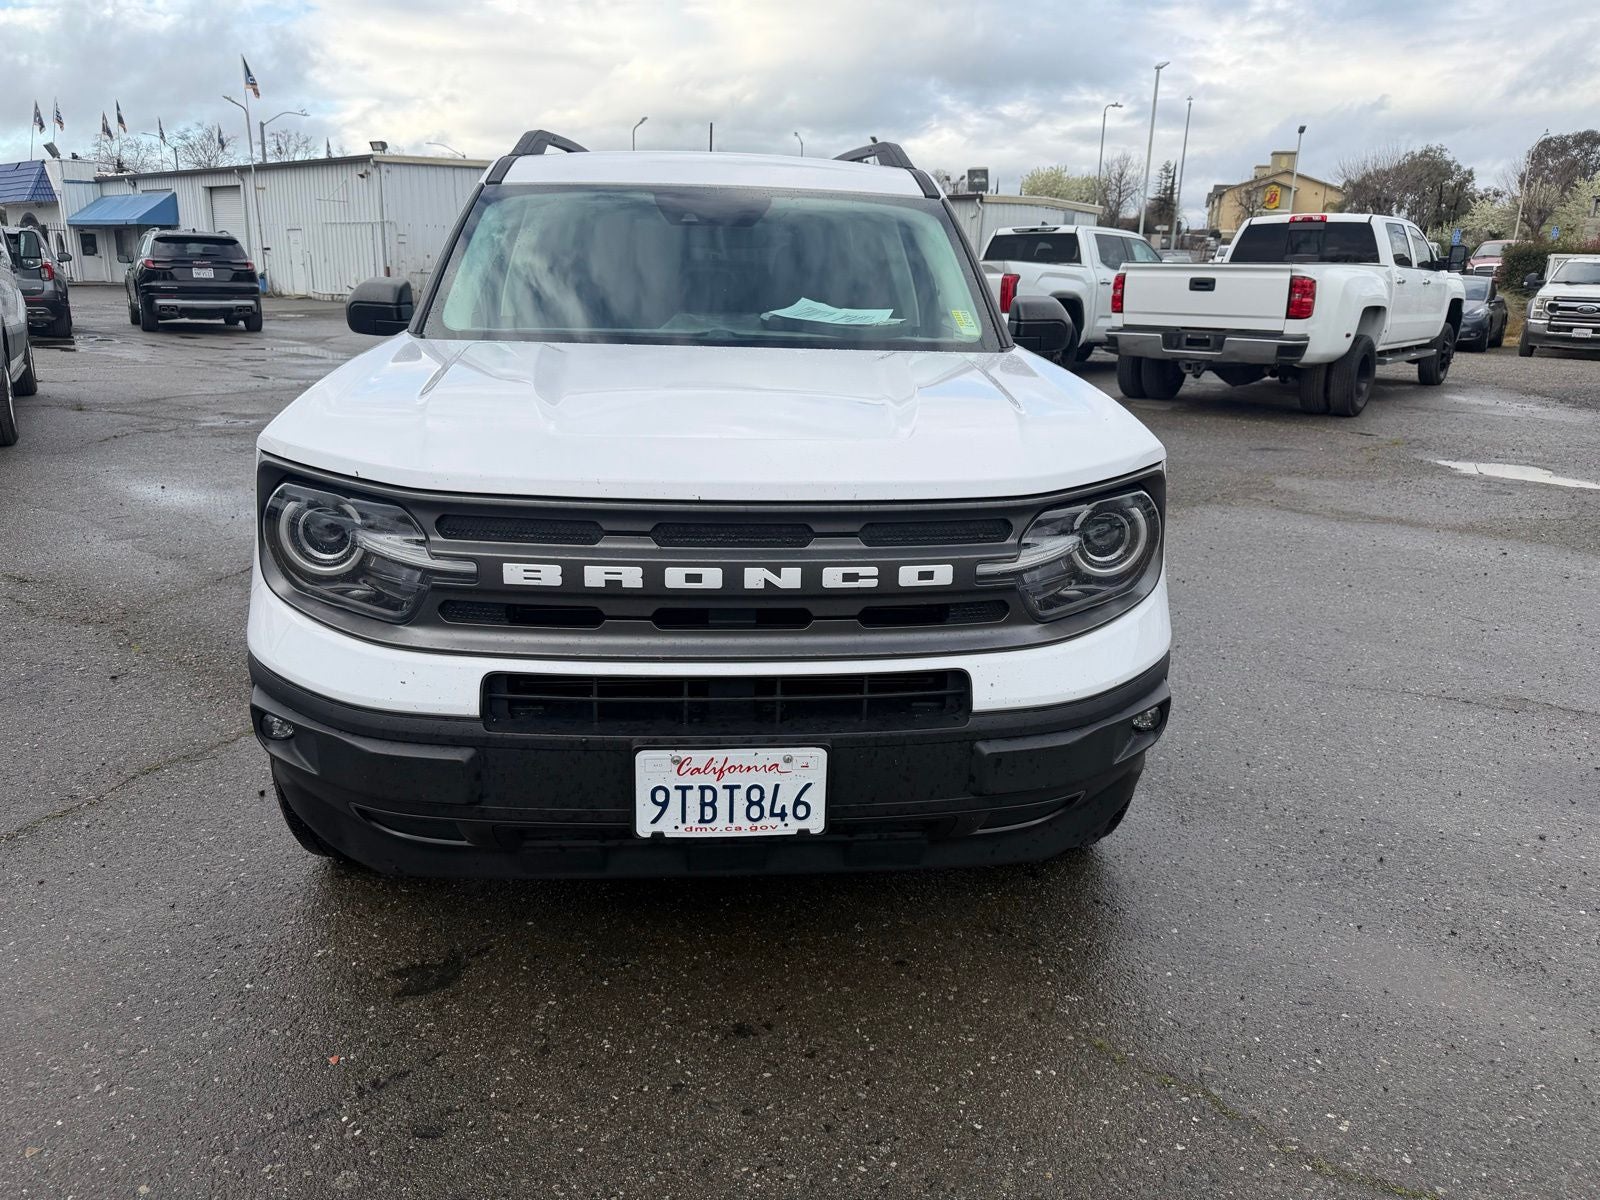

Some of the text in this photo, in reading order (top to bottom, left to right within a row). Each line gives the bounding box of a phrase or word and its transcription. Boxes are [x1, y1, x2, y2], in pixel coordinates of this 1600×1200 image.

[502, 562, 954, 589] BRONCO
[676, 756, 793, 782] California
[649, 782, 814, 825] 9TBT846
[684, 823, 778, 833] dmv.ca.gov
